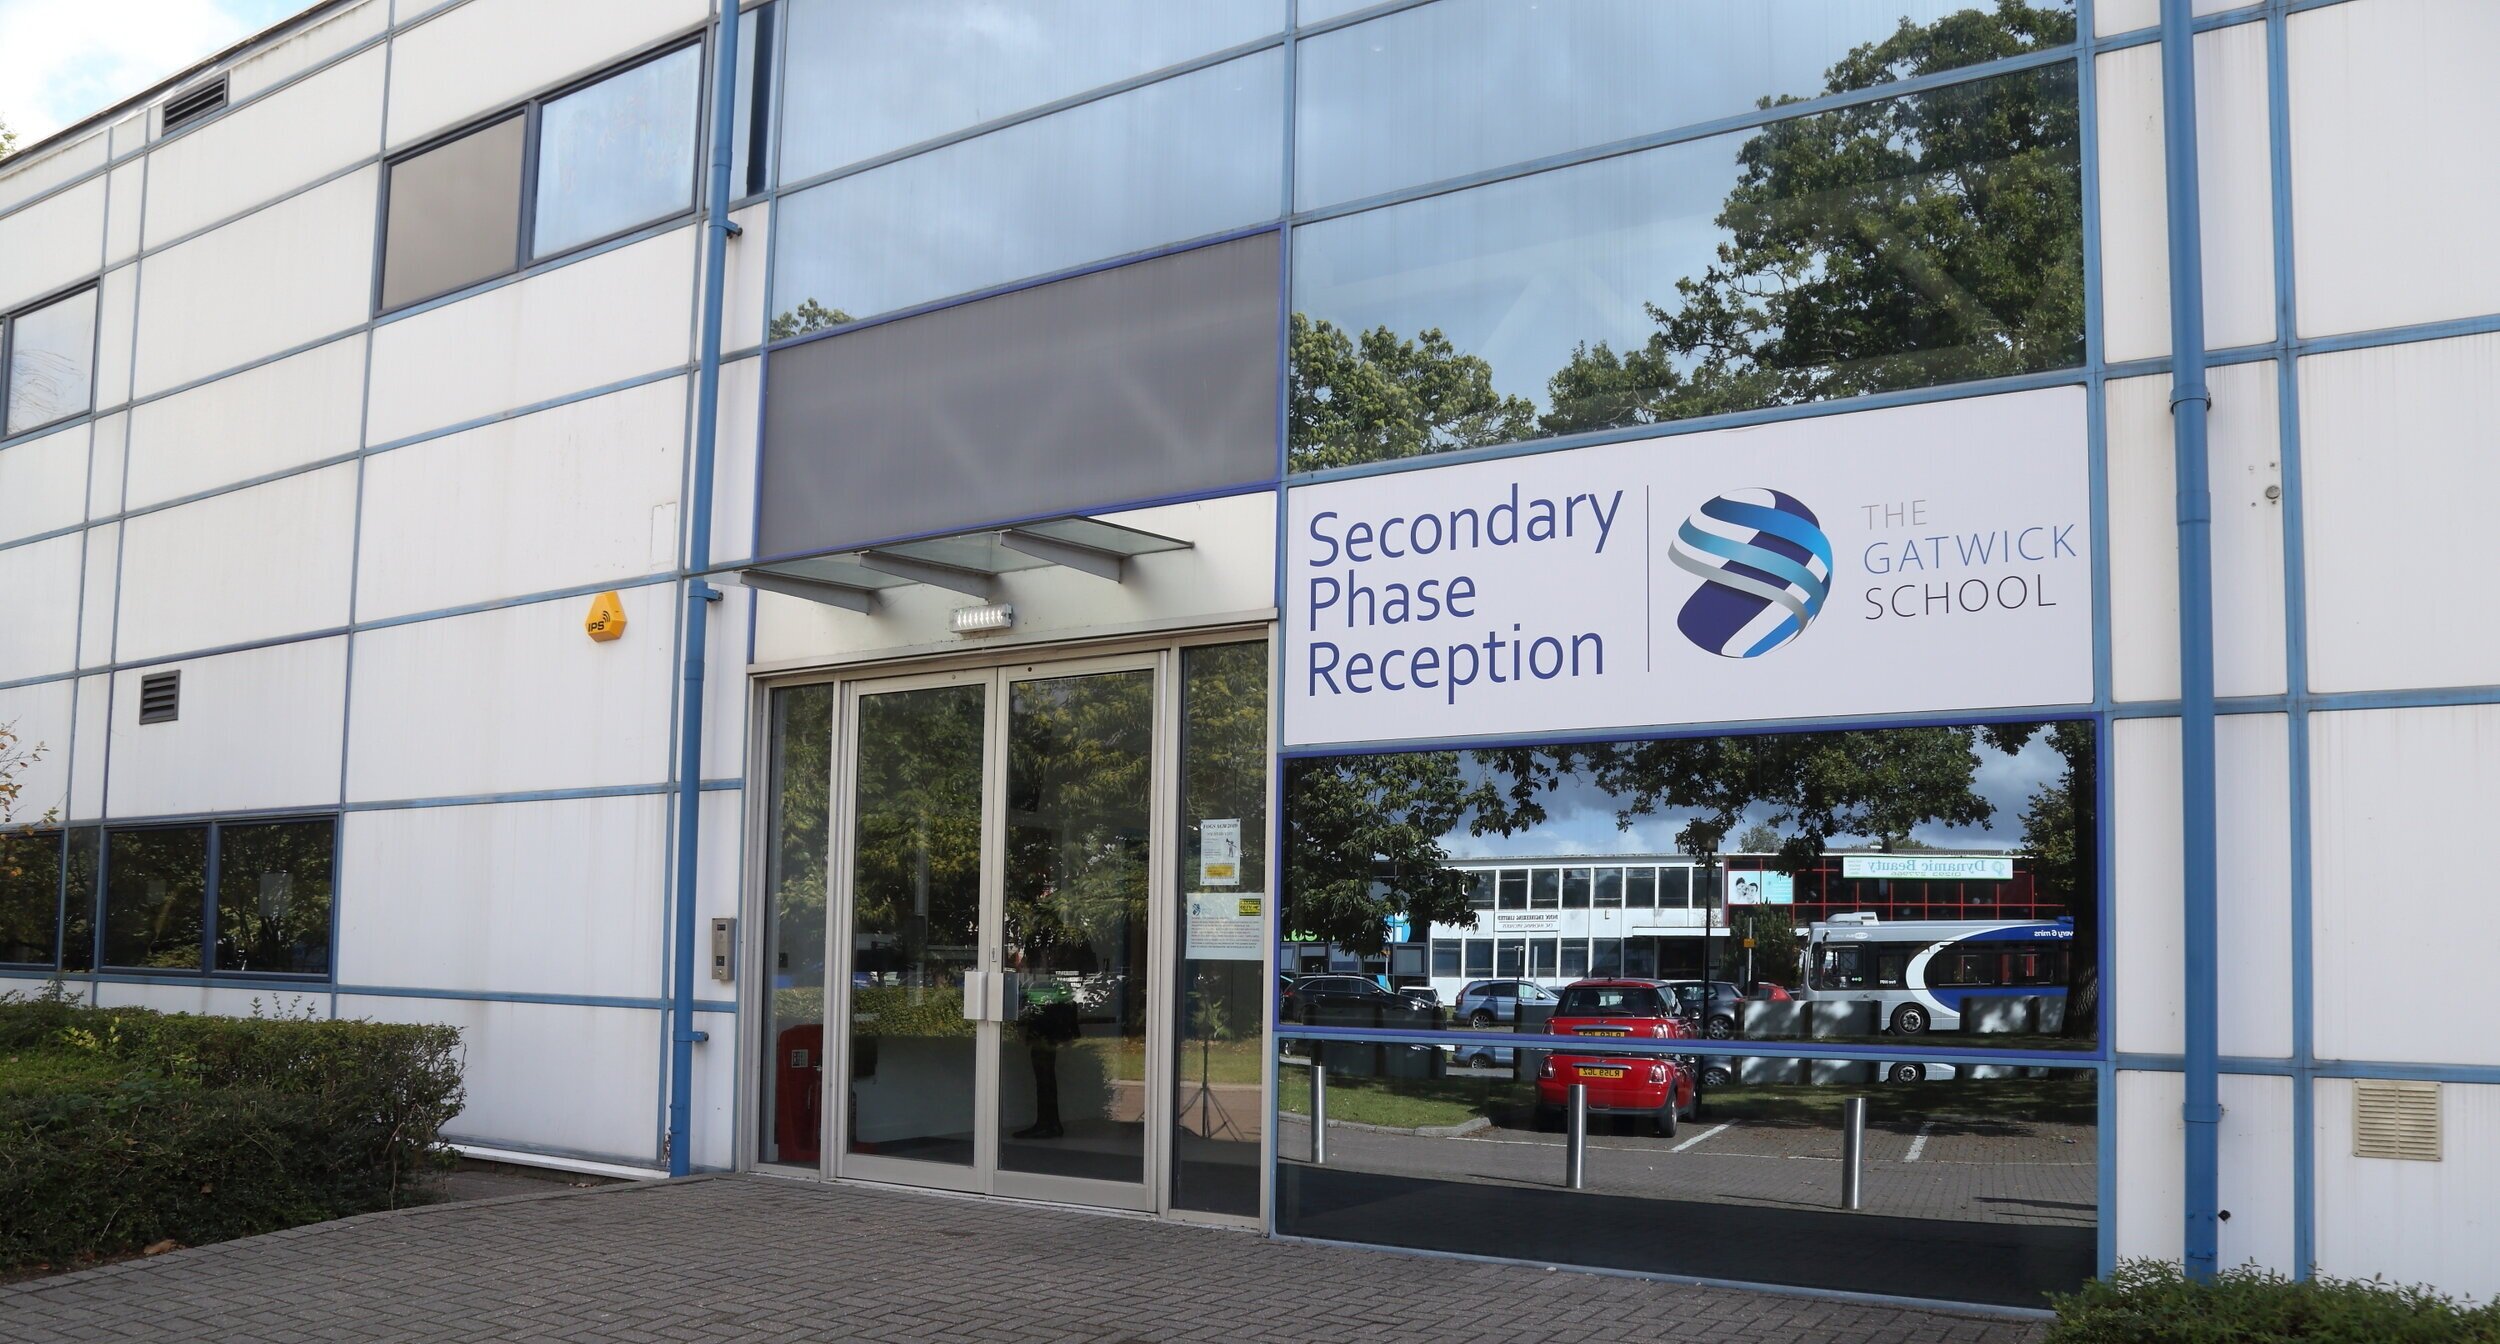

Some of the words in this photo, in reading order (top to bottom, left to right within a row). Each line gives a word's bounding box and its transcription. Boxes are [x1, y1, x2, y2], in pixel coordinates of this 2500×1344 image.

[1310, 483, 1623, 567] Secondary
[1861, 500, 1926, 530] THE
[1863, 524, 2077, 574] GATWICK
[1310, 569, 1475, 631] Phase
[1865, 574, 2056, 620] SCHOOL
[588, 621, 604, 632] IPS
[1310, 624, 1602, 704] Reception
